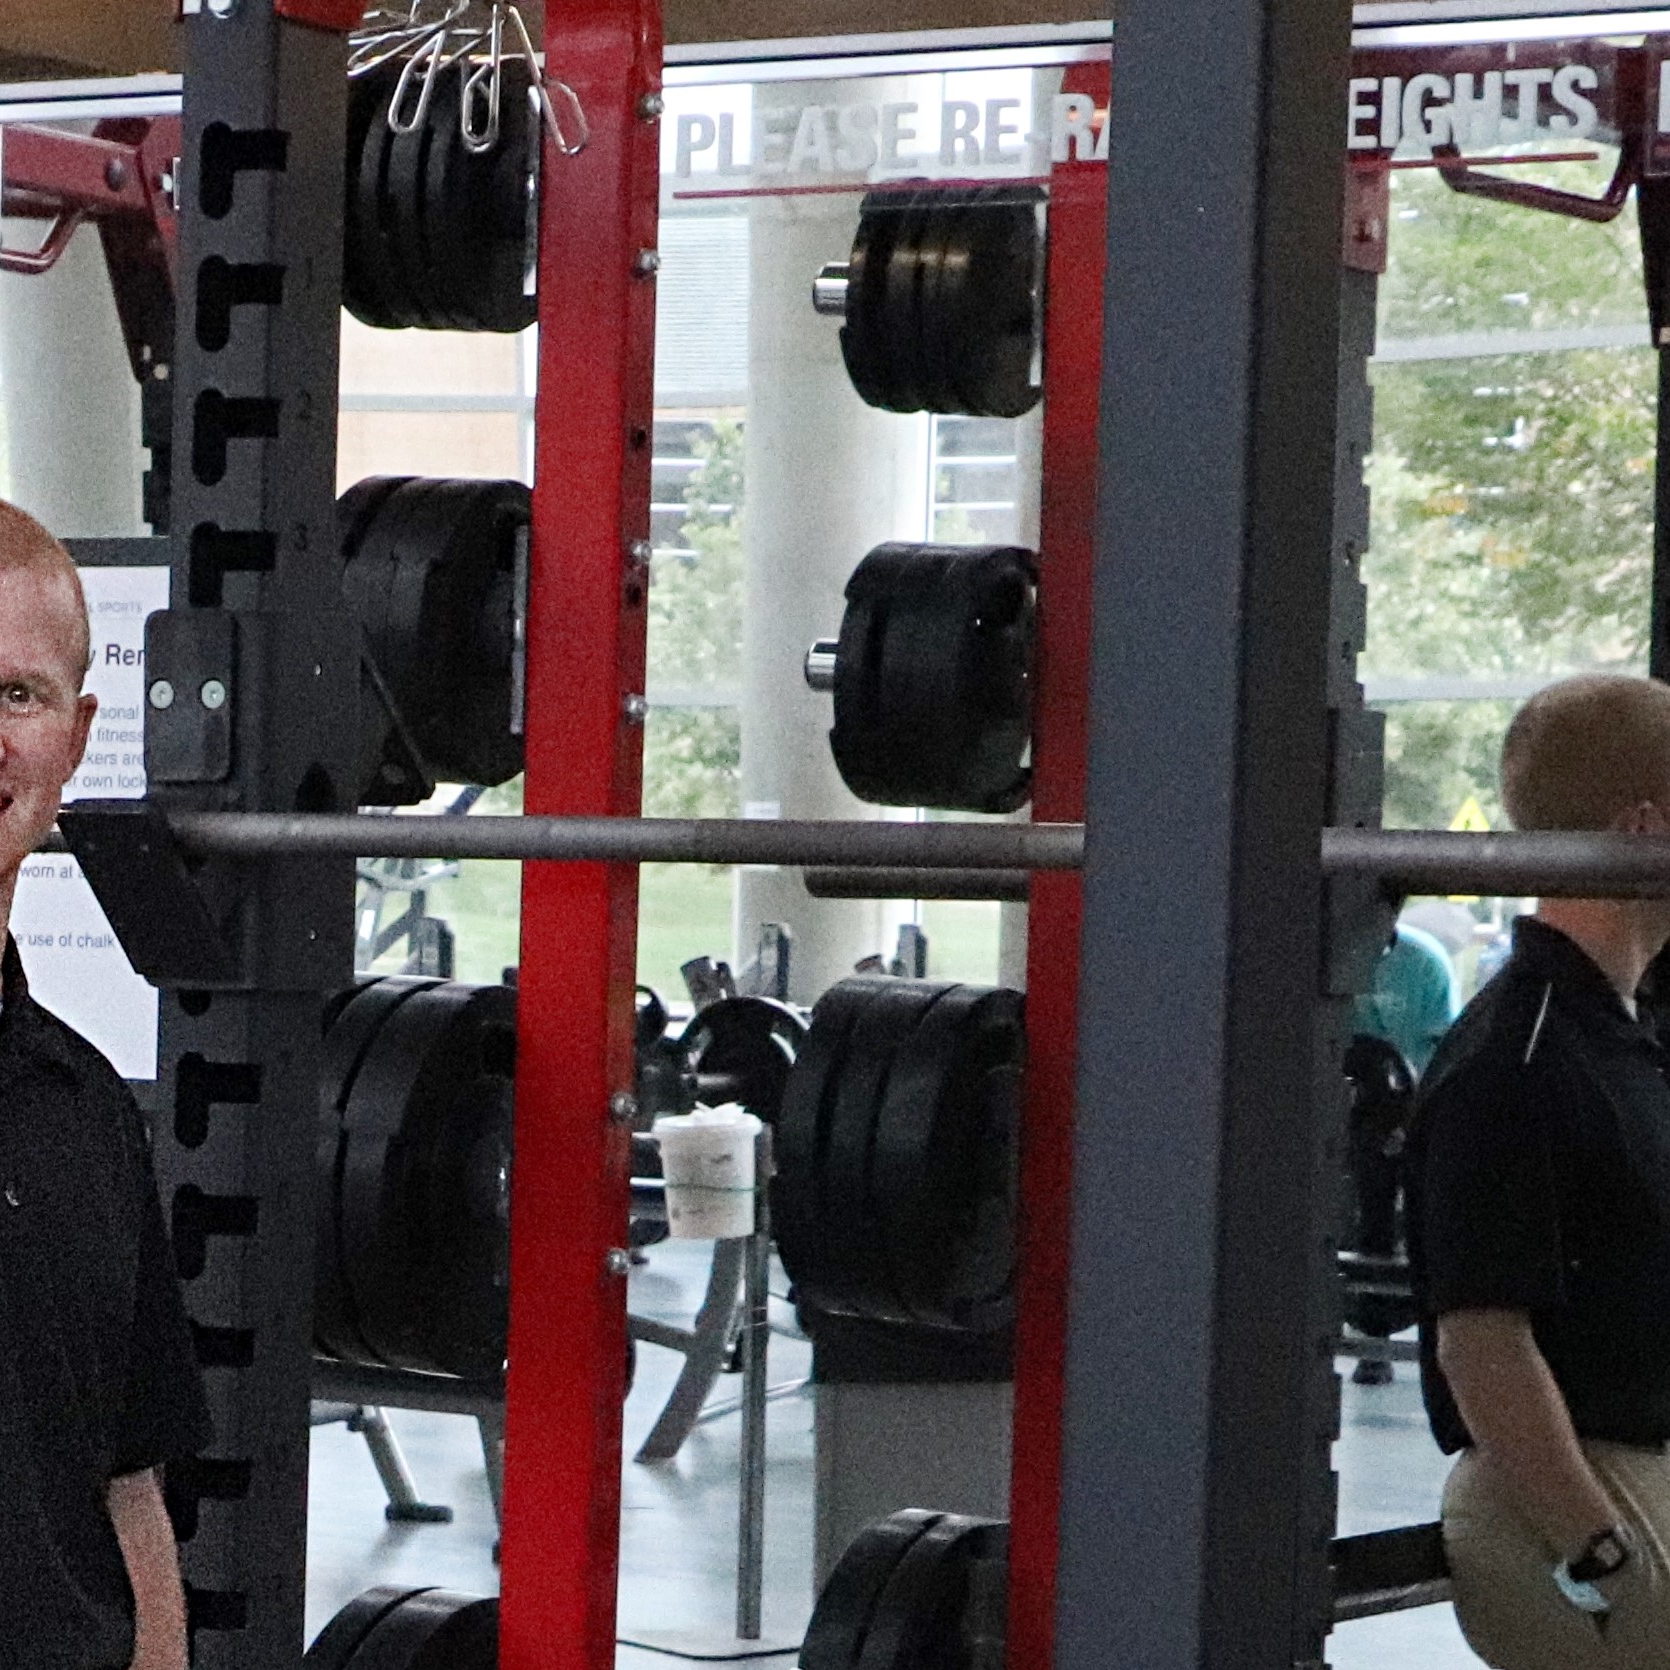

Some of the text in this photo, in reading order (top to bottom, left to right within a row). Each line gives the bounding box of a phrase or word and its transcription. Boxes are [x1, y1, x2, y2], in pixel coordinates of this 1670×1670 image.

[674, 102, 919, 179] PLEASE
[1347, 63, 1599, 150] EIGHTS
[99, 704, 139, 720] sonal
[82, 775, 113, 788] own
[20, 866, 55, 879] worn
[59, 864, 73, 879] at
[28, 934, 54, 947] use
[58, 932, 73, 948] of
[77, 931, 117, 949] chalk
